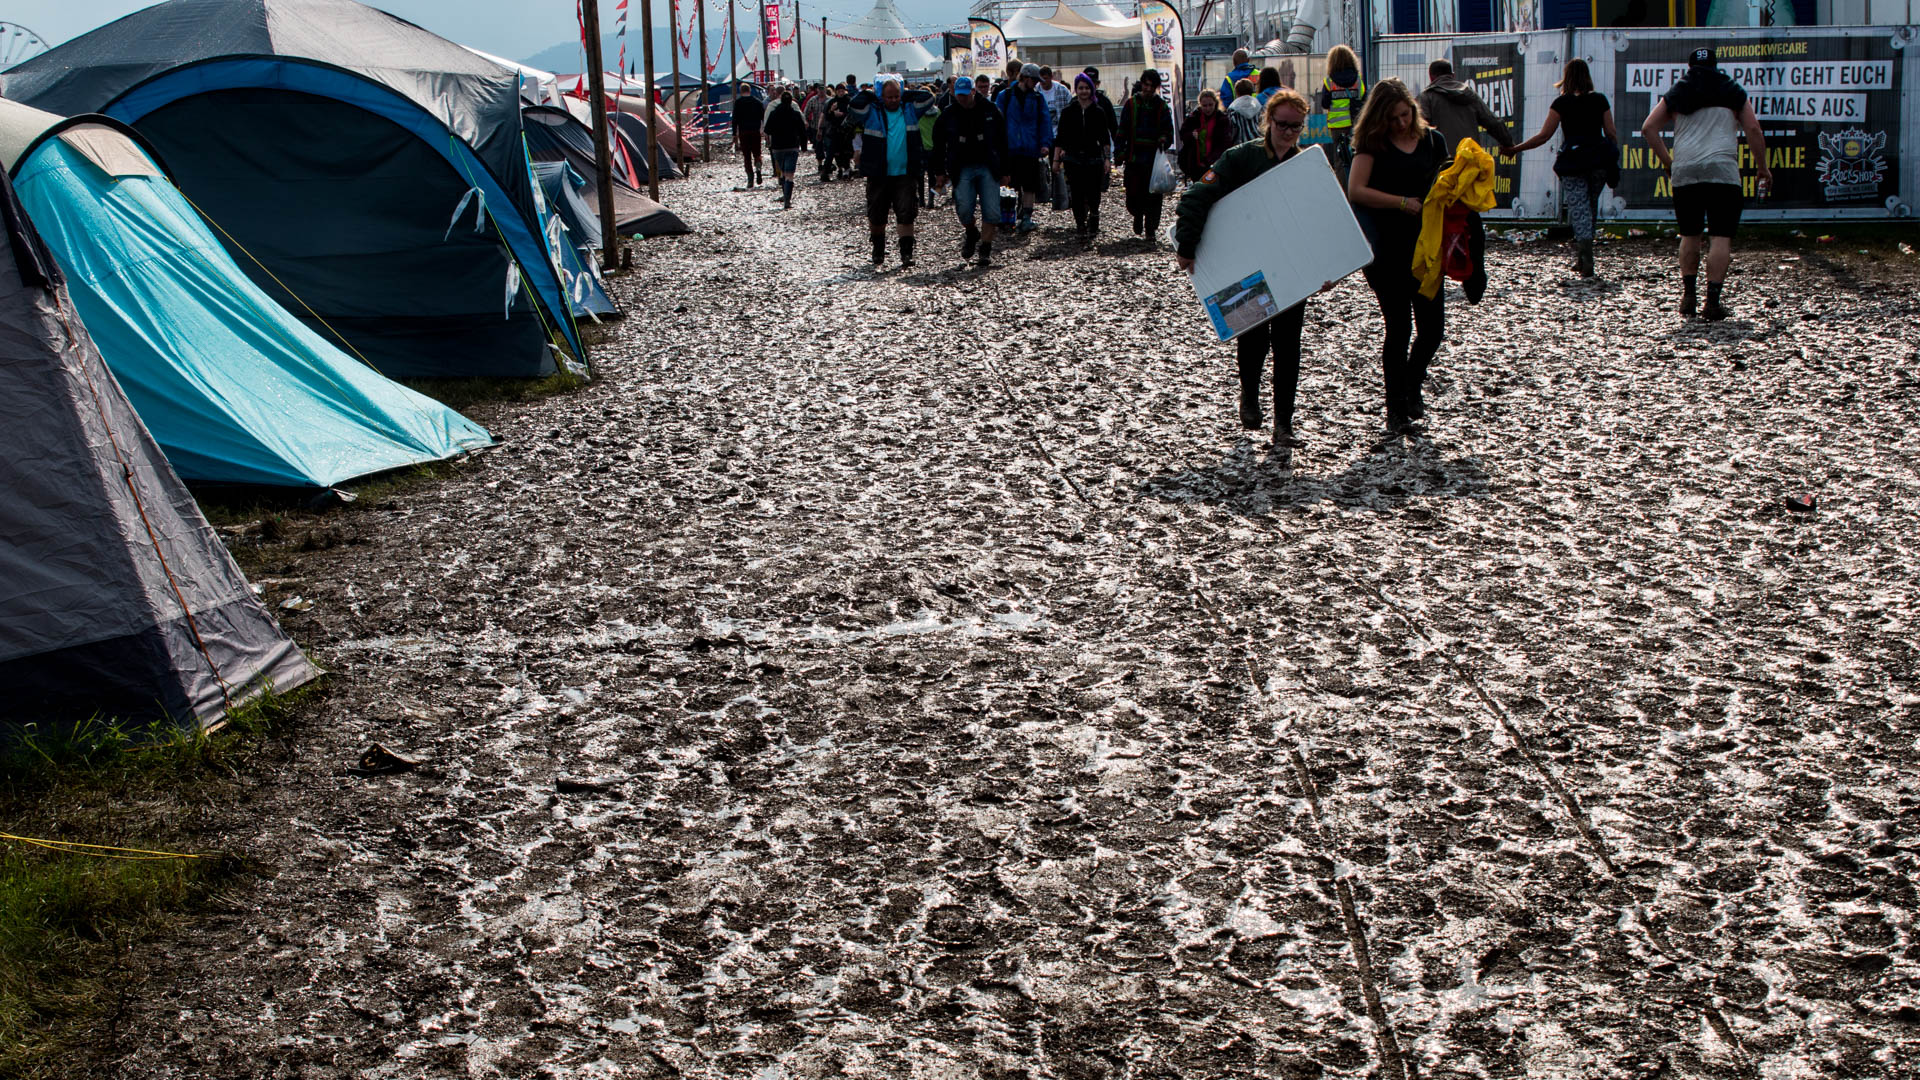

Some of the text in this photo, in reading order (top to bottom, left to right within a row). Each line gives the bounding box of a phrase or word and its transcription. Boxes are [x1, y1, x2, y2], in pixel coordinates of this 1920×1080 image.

[1696, 49, 1708, 58] 99
[1715, 42, 1808, 57] #YOUROCKWECARE
[1632, 69, 1665, 88] AUF
[1733, 67, 1786, 86] PARTY
[1791, 66, 1834, 85] GEHT
[1840, 65, 1886, 85] EUCH
[1749, 96, 1859, 117] IEMALS AUS.
[1622, 143, 1643, 169] IN
